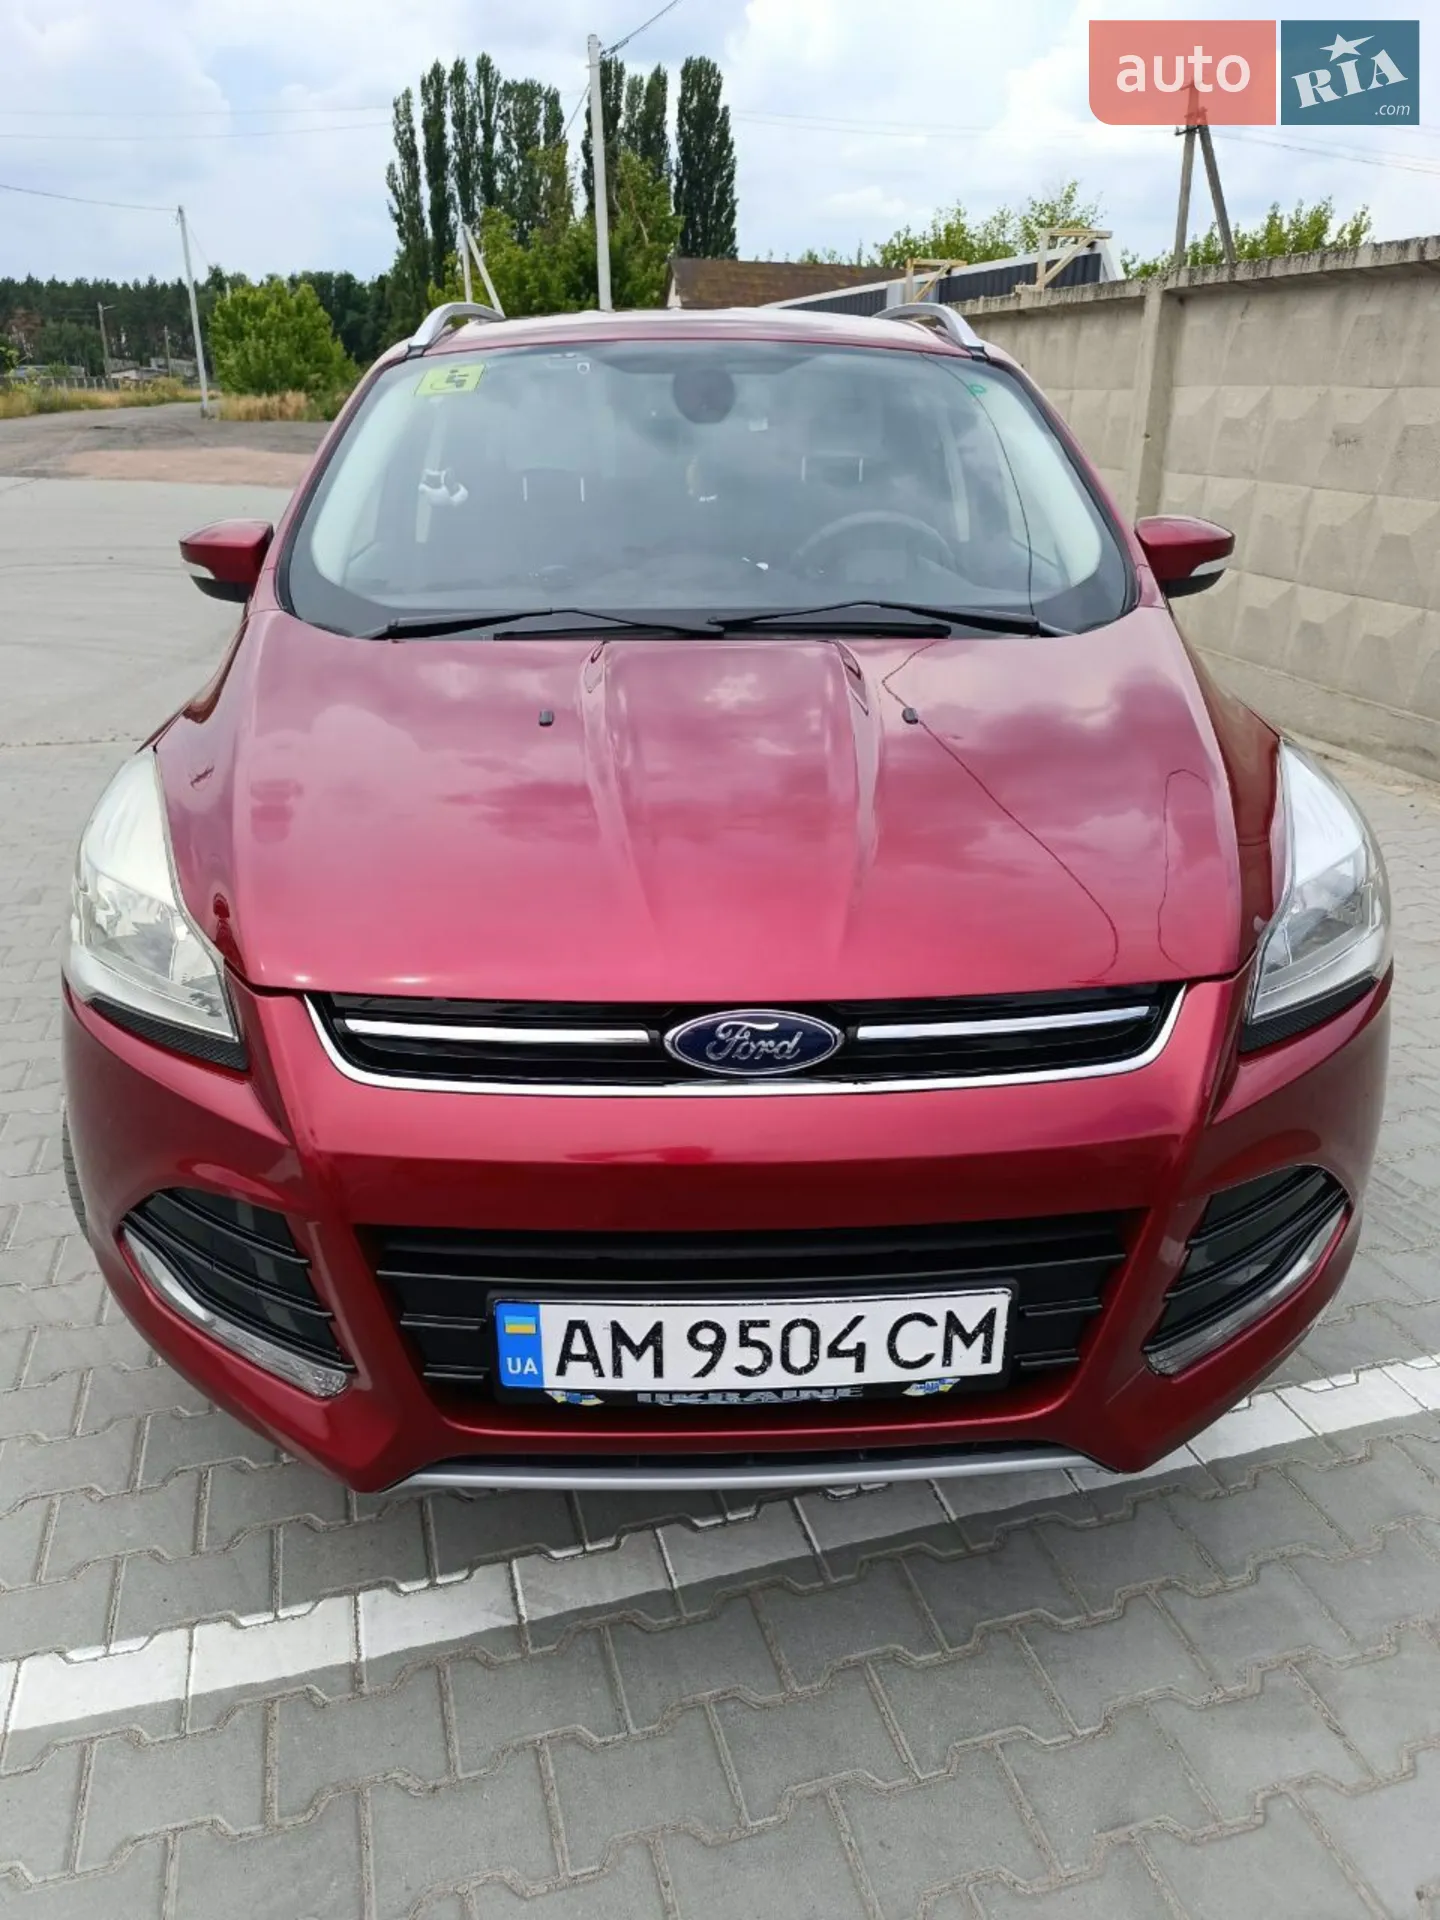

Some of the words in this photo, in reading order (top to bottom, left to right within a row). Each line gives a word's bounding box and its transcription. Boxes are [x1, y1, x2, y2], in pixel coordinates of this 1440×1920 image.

[705, 1020, 803, 1061] Ford
[555, 1319, 664, 1379] AM
[686, 1314, 867, 1379] 9504
[887, 1307, 998, 1370] CM
[506, 1356, 539, 1375] UA
